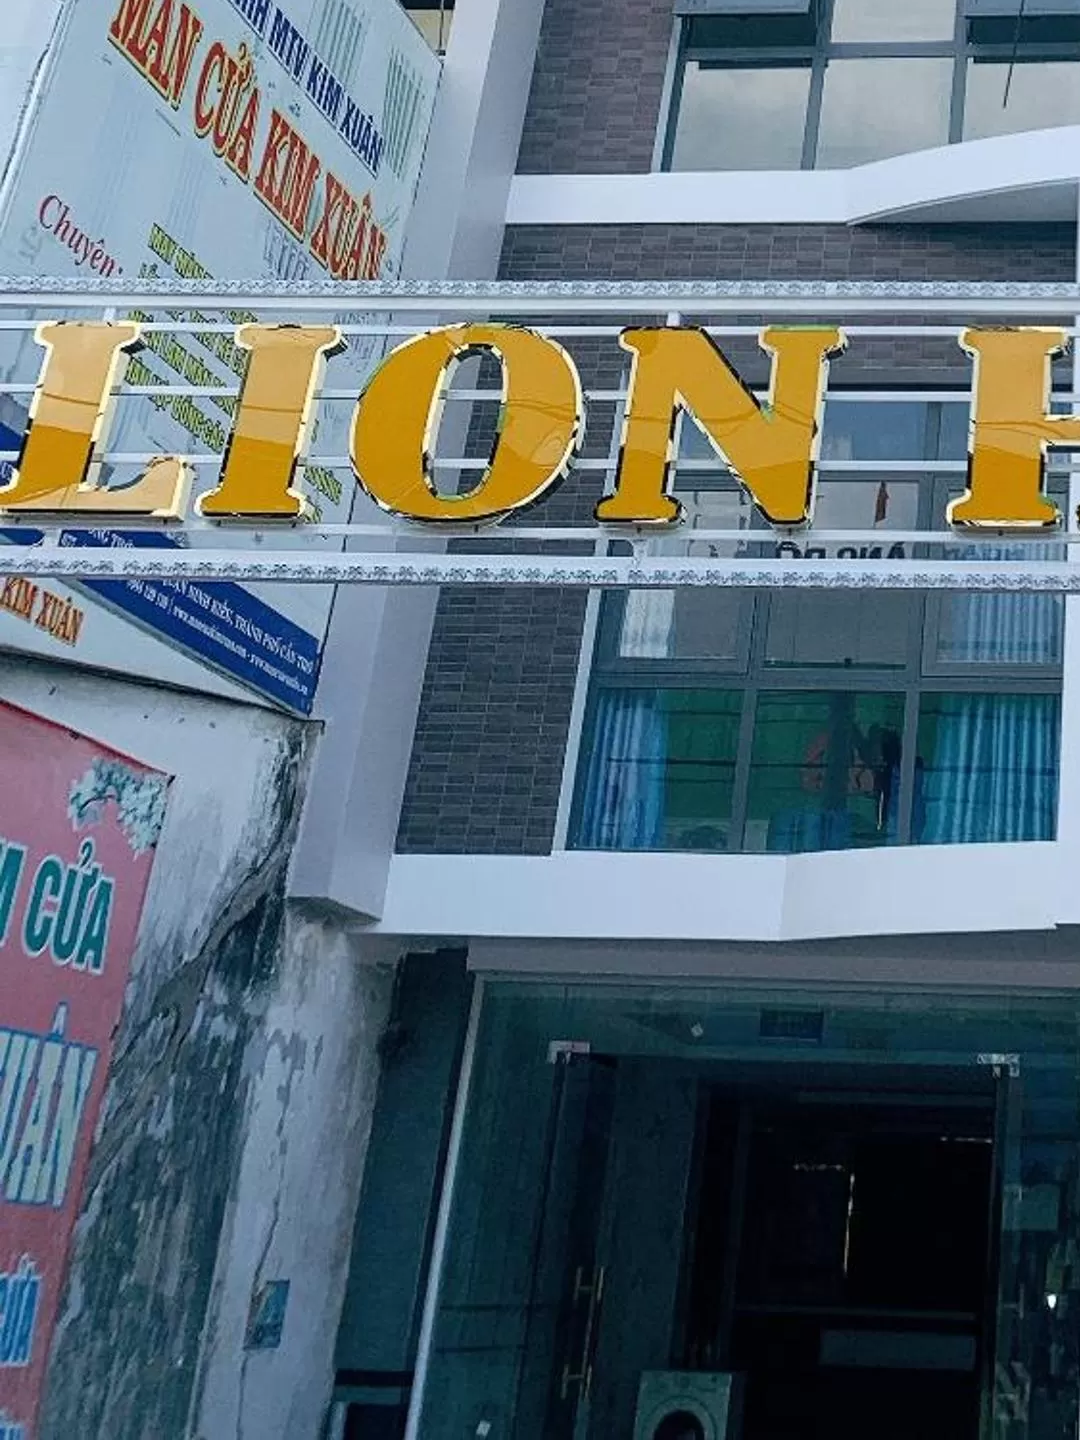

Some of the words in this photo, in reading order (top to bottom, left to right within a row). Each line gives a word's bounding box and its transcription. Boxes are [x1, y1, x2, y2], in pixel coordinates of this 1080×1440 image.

[194, 40, 260, 184] CỬA
[252, 109, 322, 244] KIM
[308, 171, 388, 280] XUÂN
[267, 6, 310, 81] MTV
[306, 55, 346, 124] KIM
[339, 95, 385, 174] XUÂN
[0, 321, 849, 532] LION
[23, 835, 116, 975] CỬA
